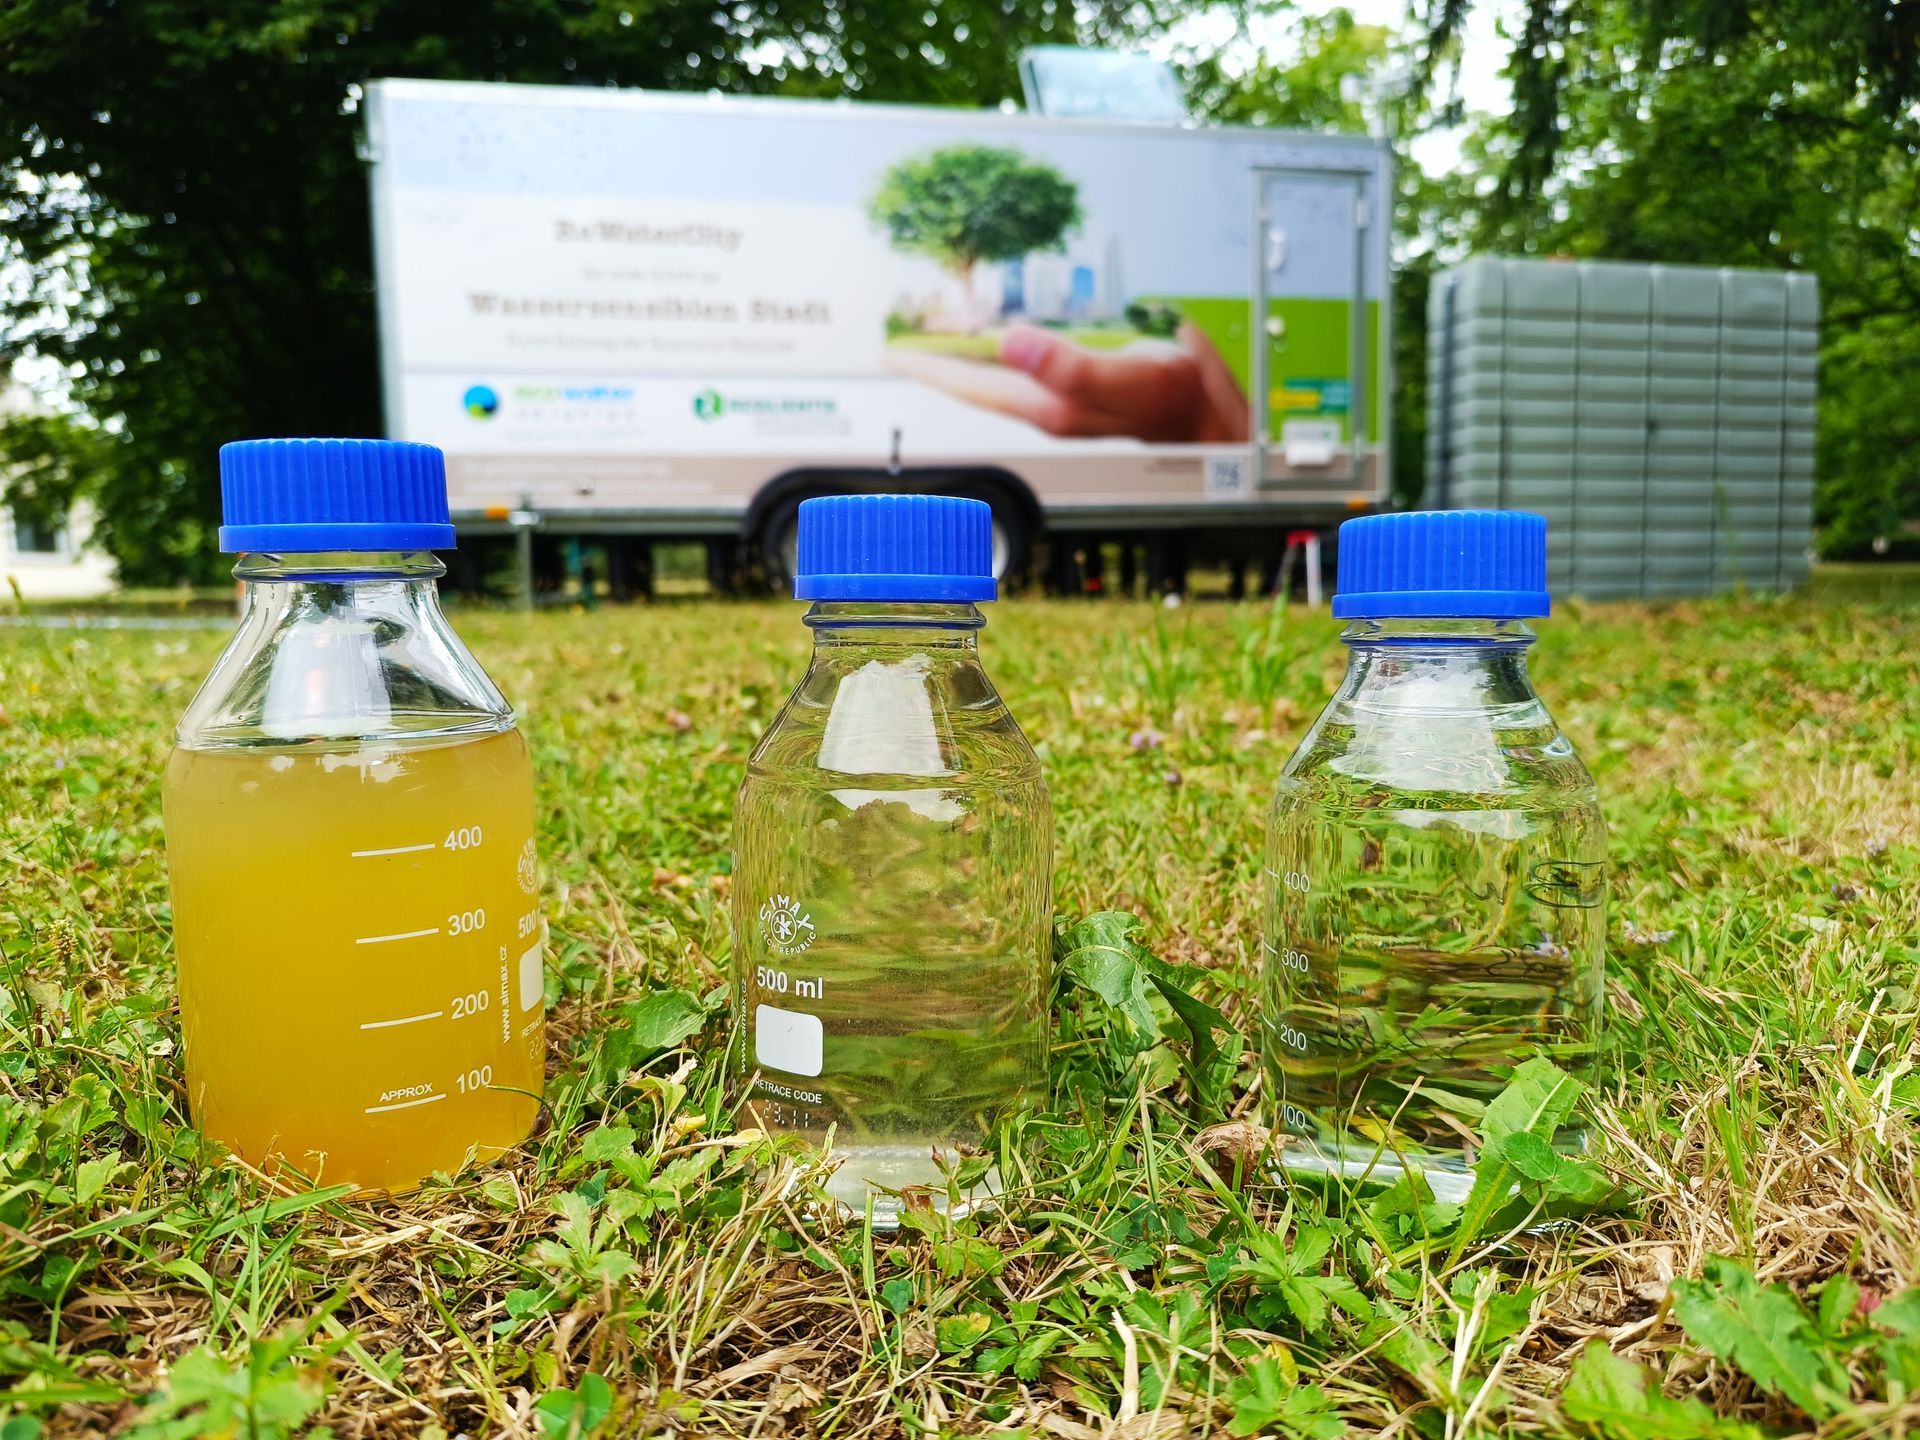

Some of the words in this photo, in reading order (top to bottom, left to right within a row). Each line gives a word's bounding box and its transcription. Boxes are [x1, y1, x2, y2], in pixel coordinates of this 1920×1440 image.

[444, 826, 482, 851] 400
[1283, 871, 1309, 893] 400
[448, 908, 485, 936] 300
[760, 894, 815, 930] SIMAX
[759, 920, 778, 950] CZECH
[778, 931, 817, 956] REPUBLIC
[1282, 947, 1309, 973] 300
[500, 943, 511, 1043] www.simax.cz
[756, 965, 788, 993] 500
[795, 976, 823, 1000] ml
[451, 989, 489, 1020] 200
[1280, 1023, 1306, 1051] 200
[379, 1082, 433, 1102] APPROX
[456, 1064, 493, 1094] 100
[754, 1078, 792, 1098] RETRACE
[793, 1089, 822, 1104] CODE
[1283, 1103, 1306, 1129] 100
